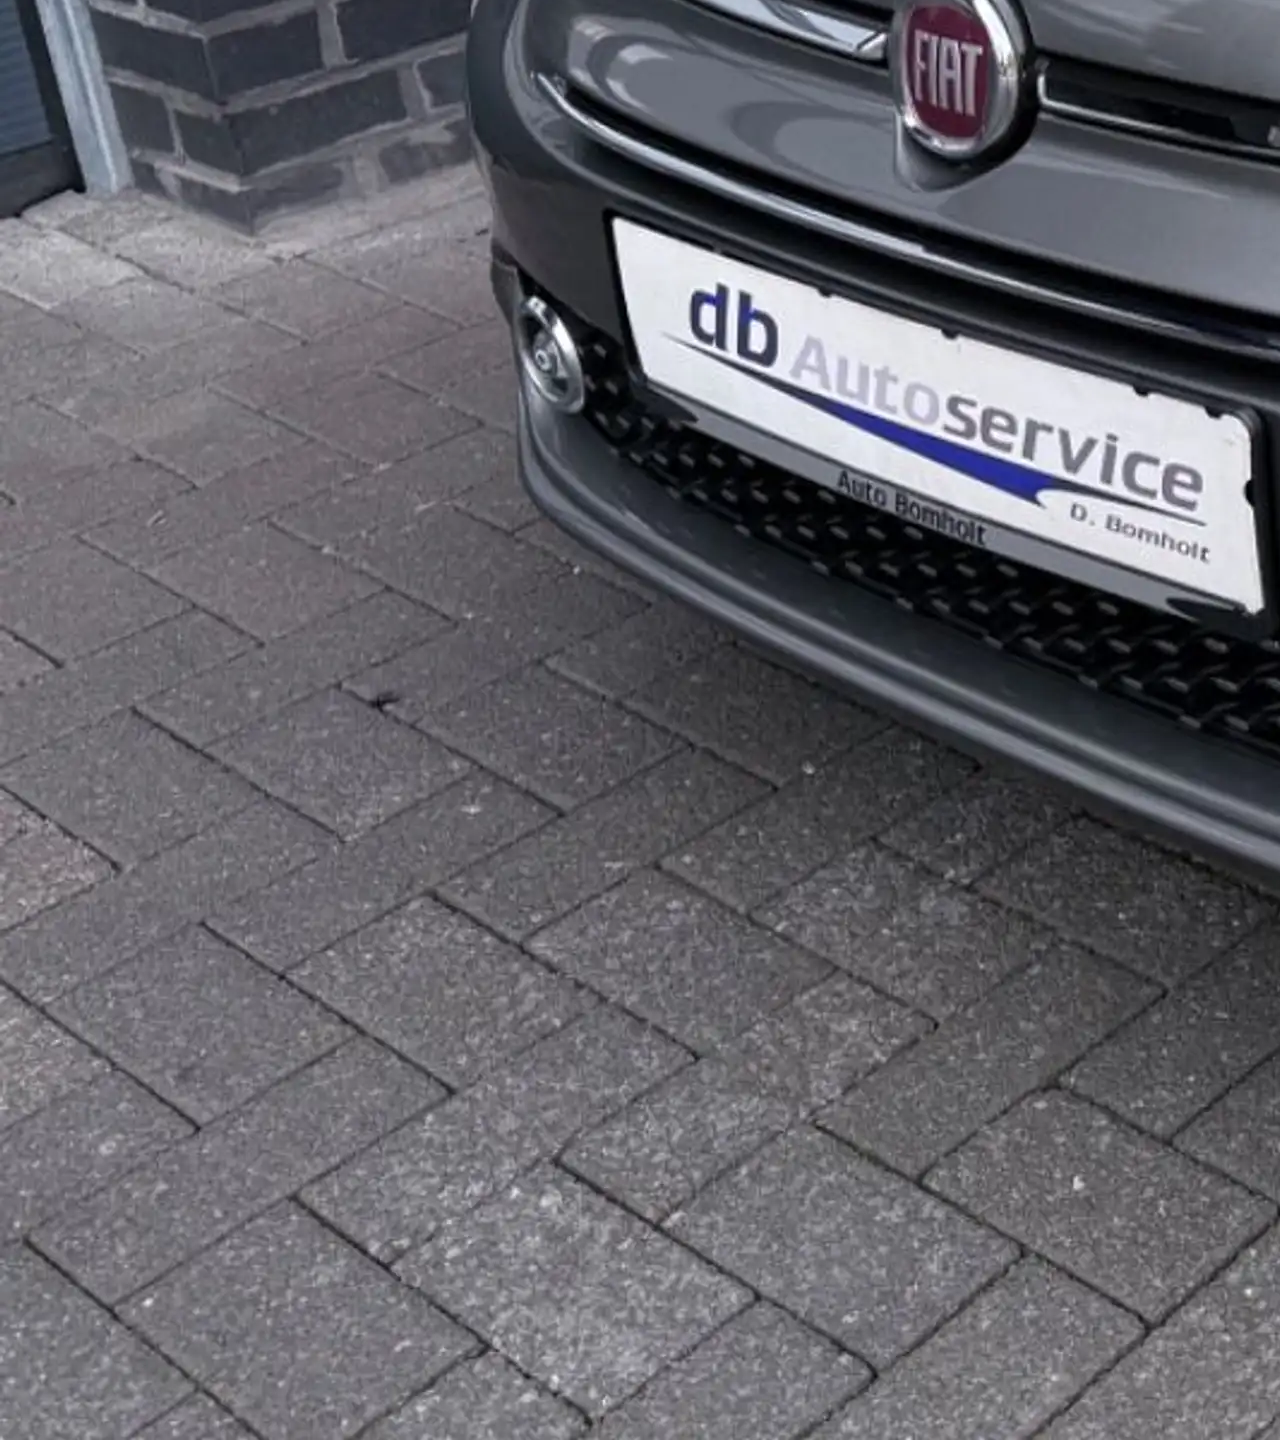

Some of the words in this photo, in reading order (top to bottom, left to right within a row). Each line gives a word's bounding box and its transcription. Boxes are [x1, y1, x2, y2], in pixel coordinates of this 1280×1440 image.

[914, 29, 983, 117] FIAT
[689, 282, 778, 368] db
[790, 335, 1204, 511] Autoservice
[838, 470, 887, 508] Auto
[894, 490, 986, 546] Bomholt
[1070, 502, 1096, 527] D.
[1105, 513, 1212, 565] Bomholt
